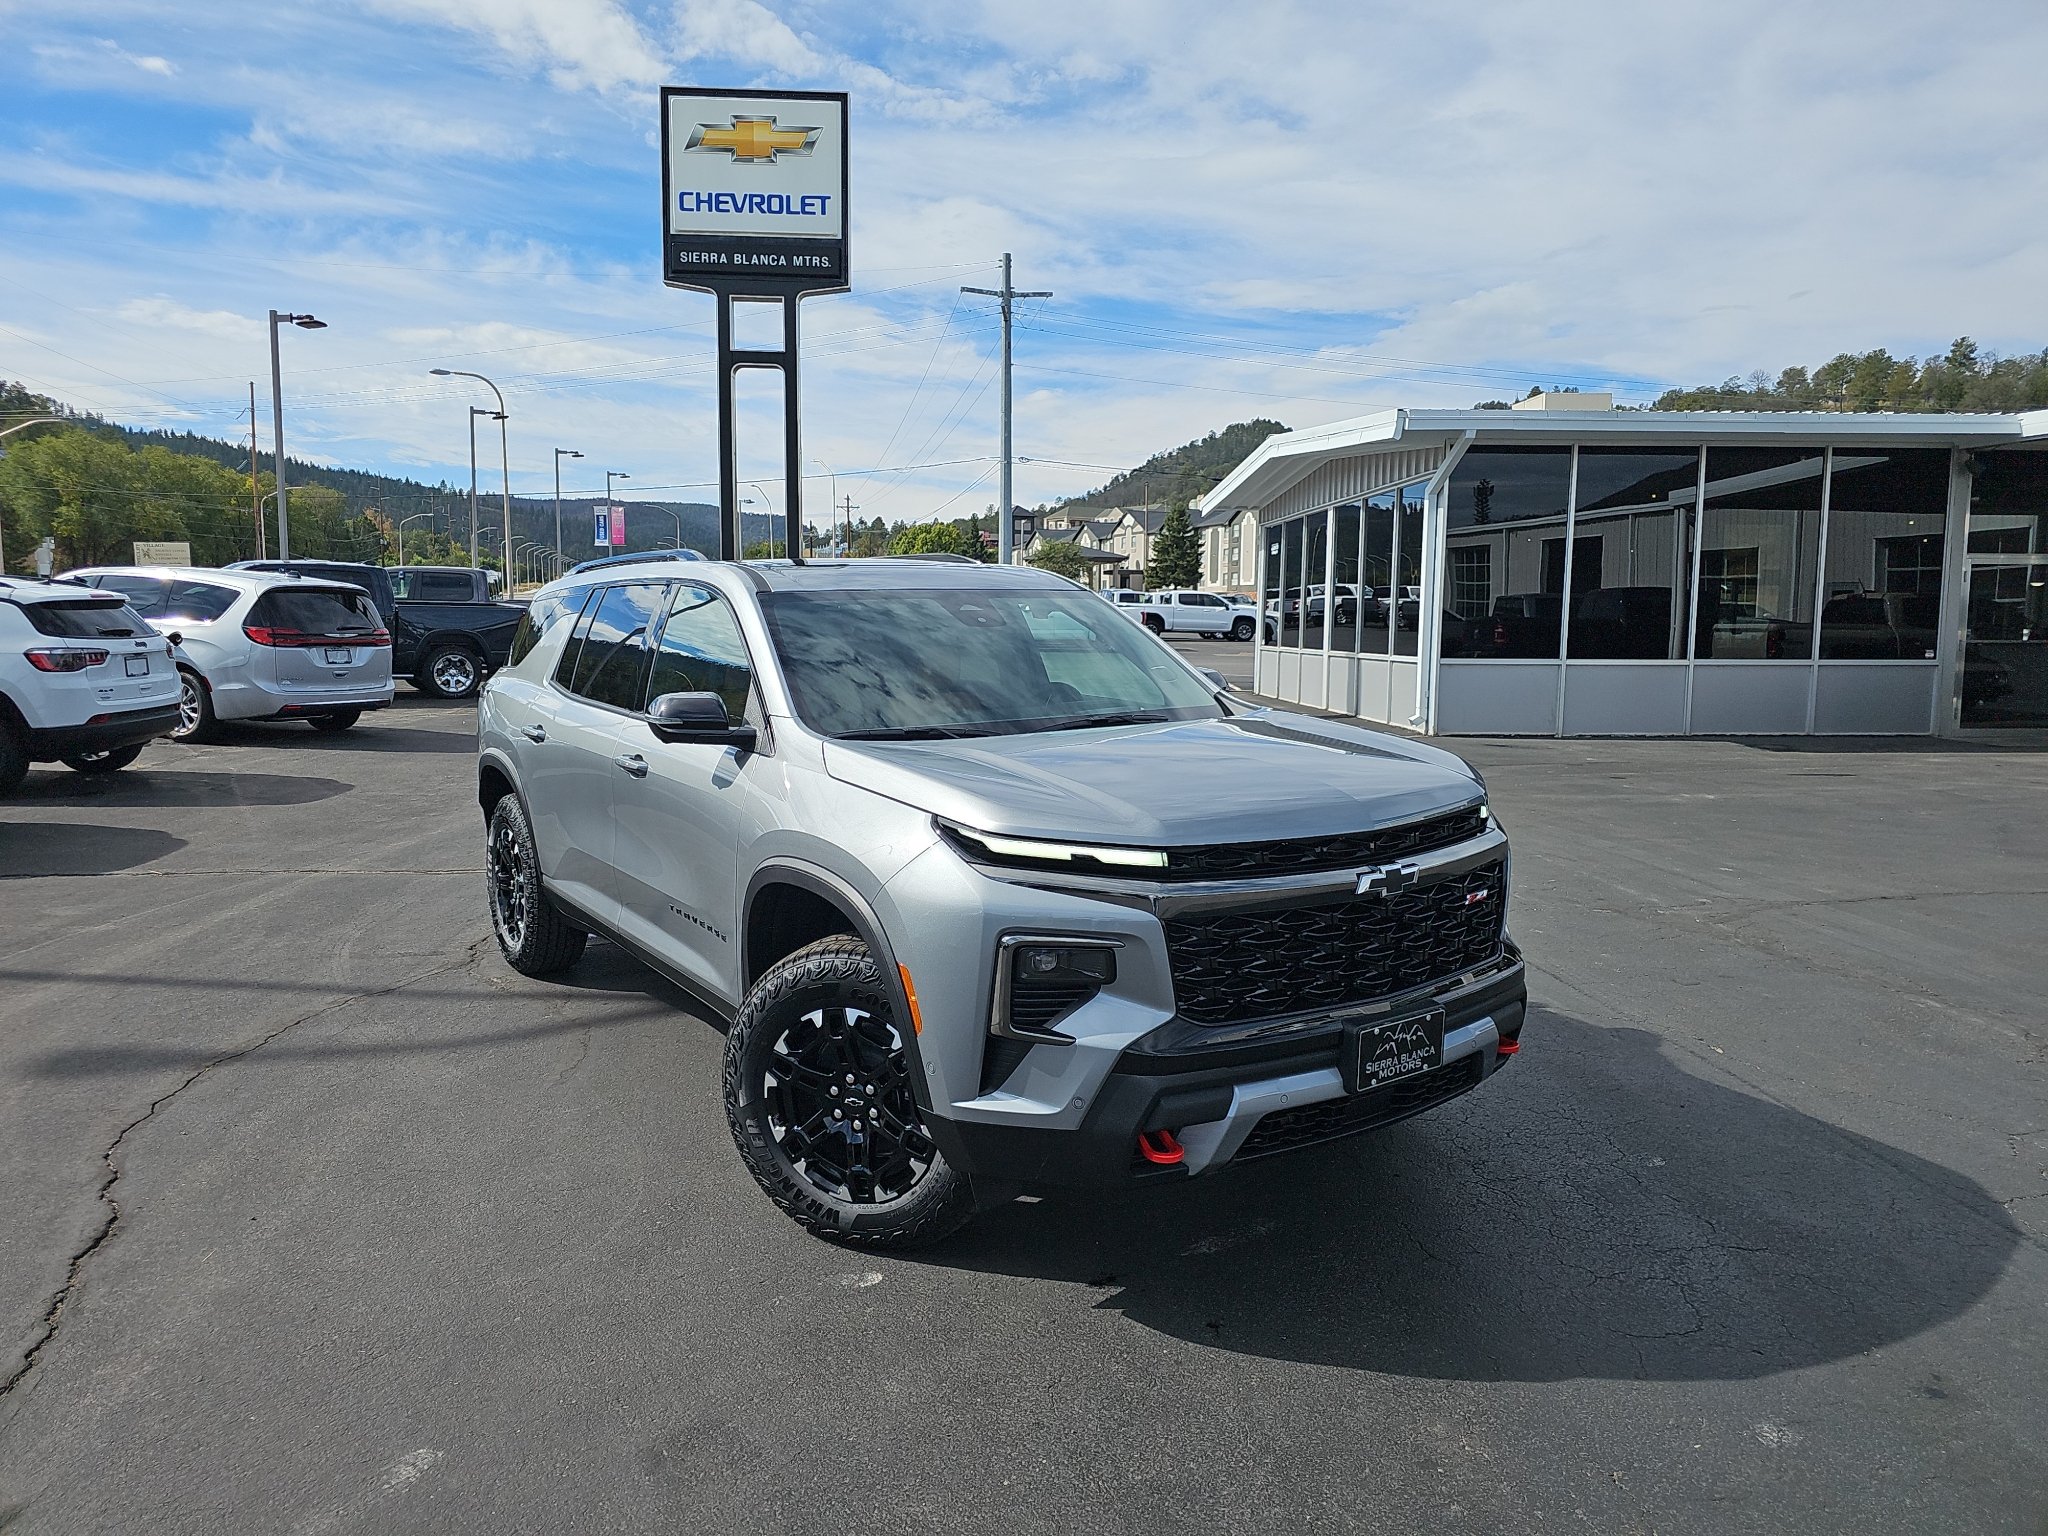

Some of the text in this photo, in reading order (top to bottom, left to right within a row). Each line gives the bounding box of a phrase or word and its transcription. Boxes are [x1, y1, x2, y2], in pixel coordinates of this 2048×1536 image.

[679, 191, 831, 215] CHEVROLET
[680, 251, 831, 267] SIERRA BLANCA MTRS.
[669, 903, 727, 943] TRAVERSE
[1365, 1045, 1436, 1074] SIERRA BLANCA
[1378, 1058, 1422, 1080] MOTORS
